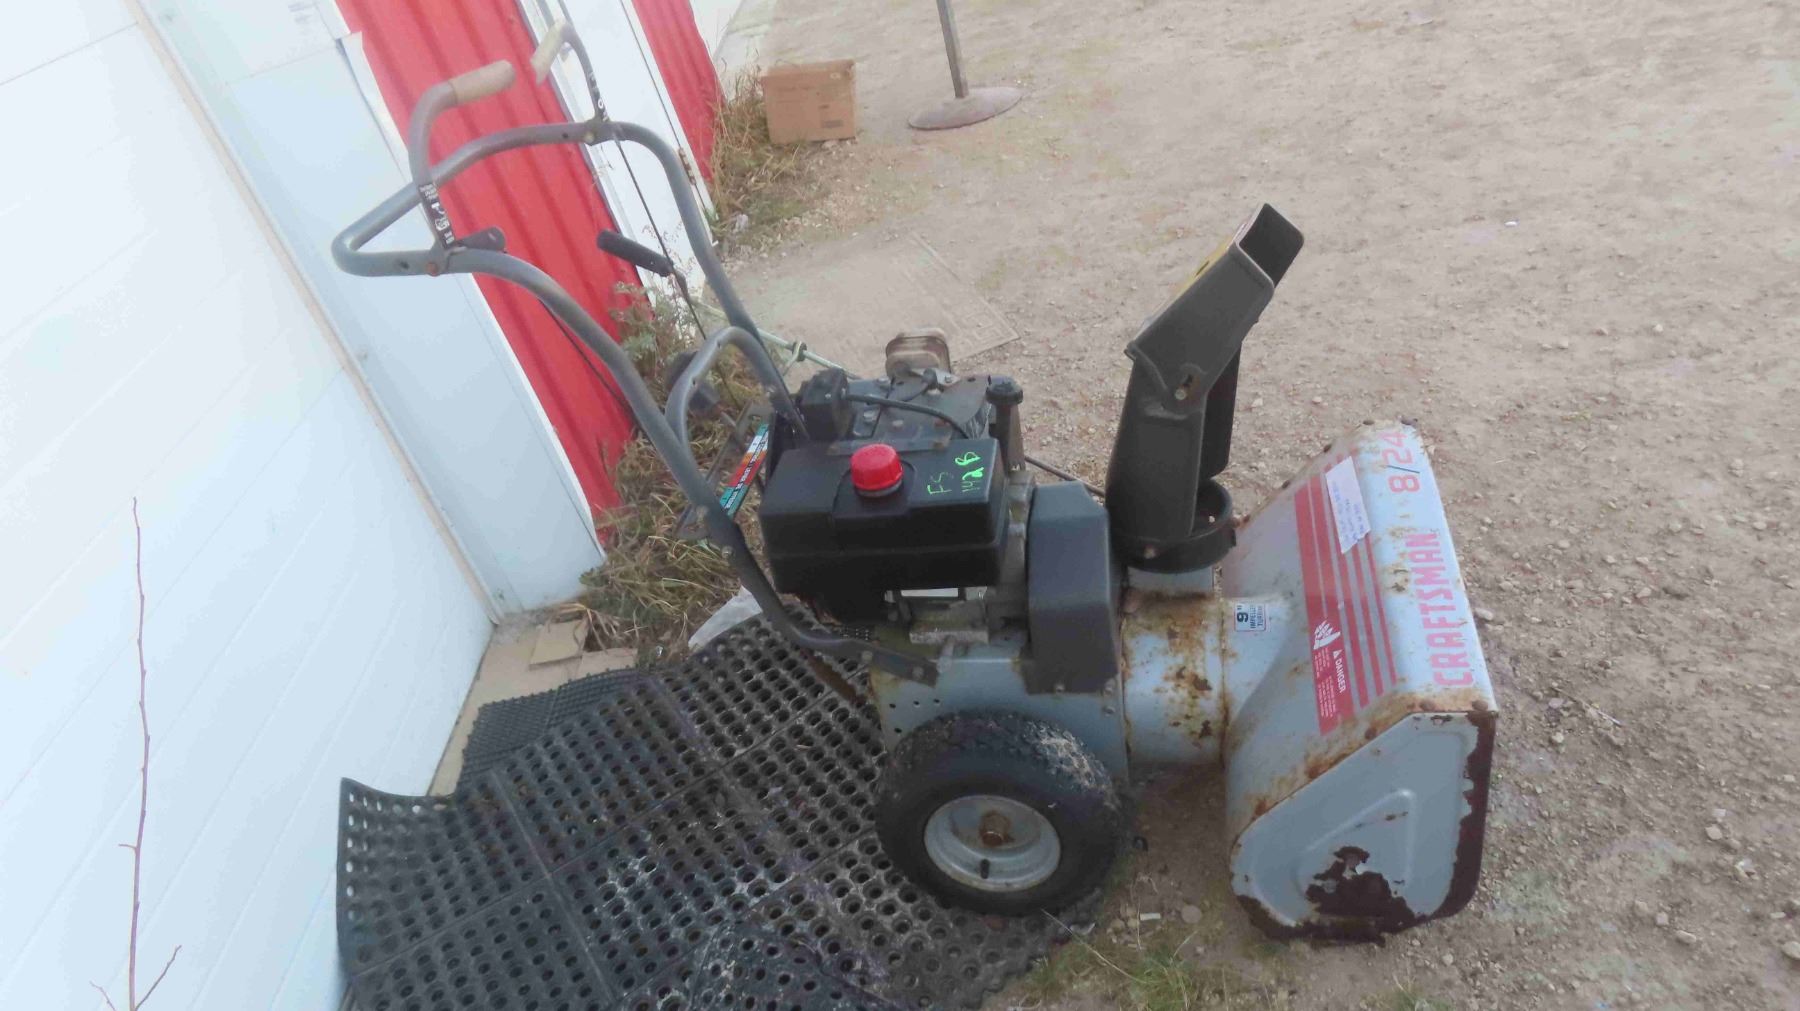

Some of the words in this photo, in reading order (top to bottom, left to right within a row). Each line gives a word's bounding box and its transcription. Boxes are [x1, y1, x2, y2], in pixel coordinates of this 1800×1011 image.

[1378, 431, 1420, 493] 8/24
[1404, 532, 1474, 686] CRAFTSMAN
[1335, 658, 1347, 694] DANGER
